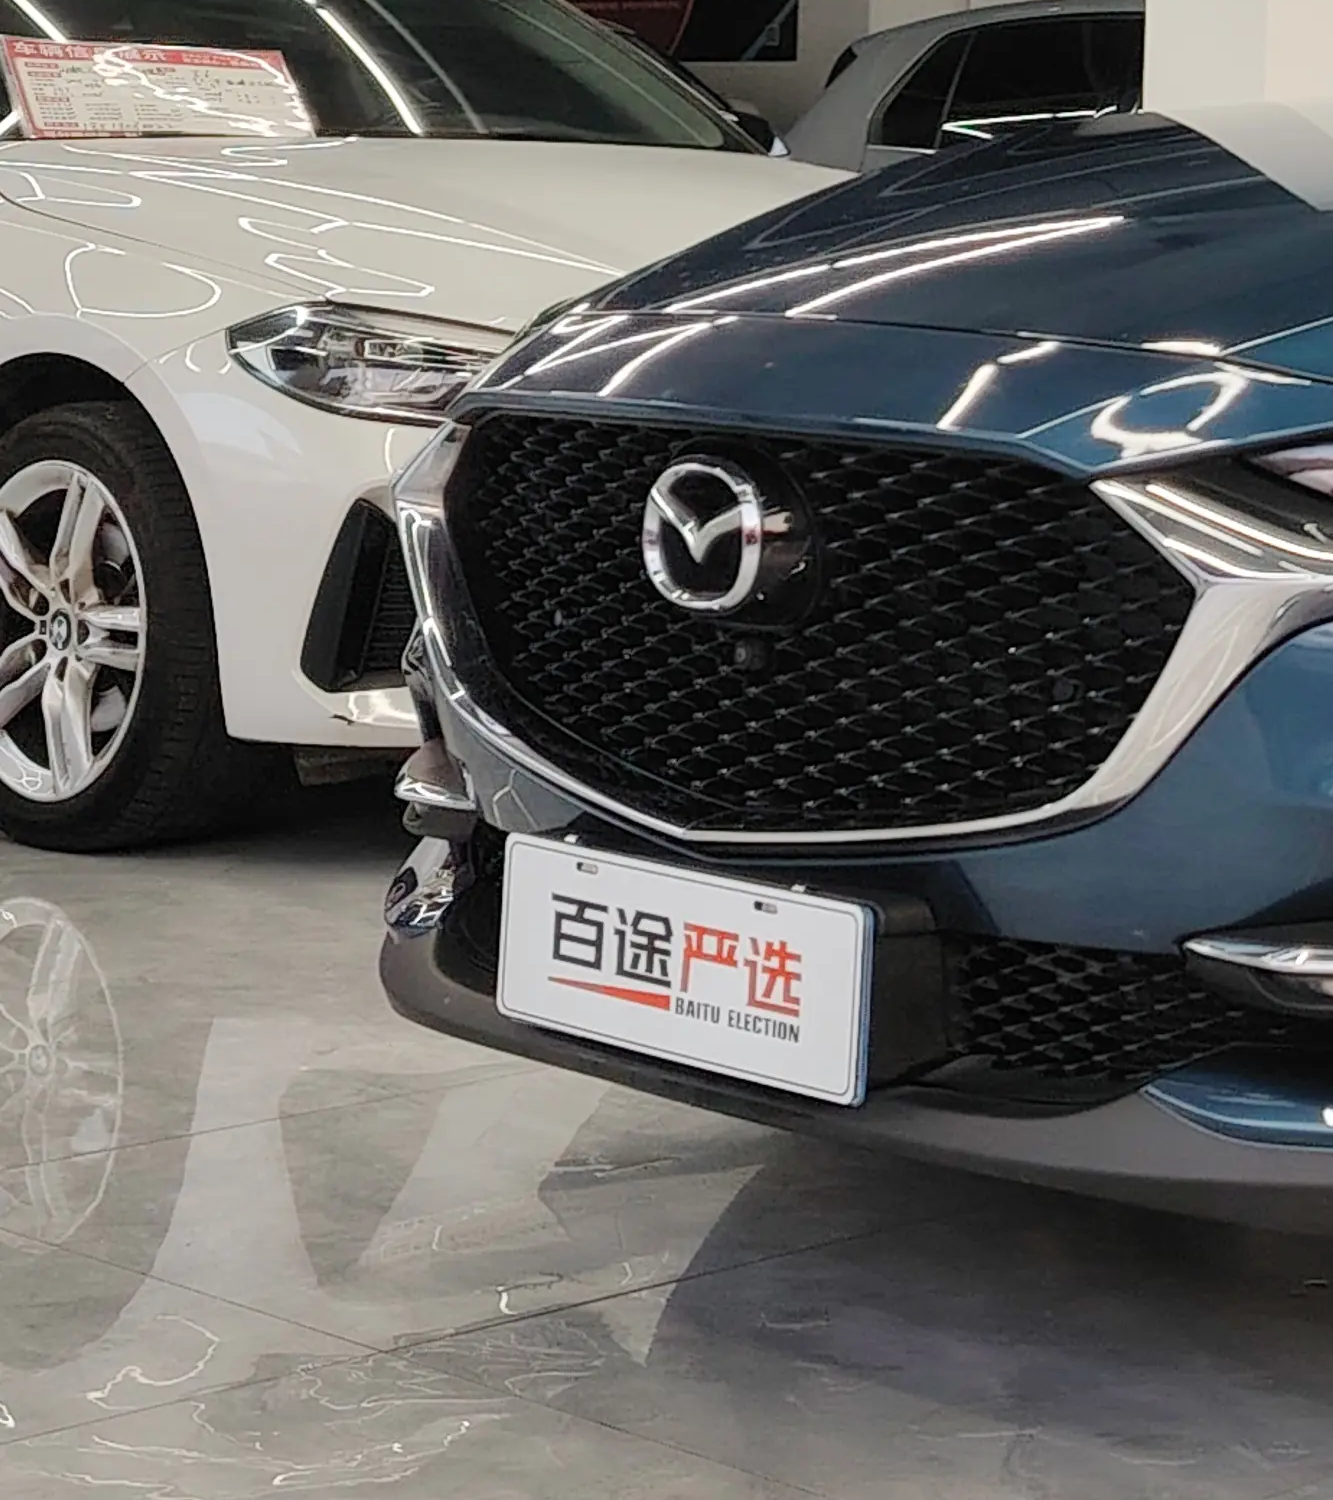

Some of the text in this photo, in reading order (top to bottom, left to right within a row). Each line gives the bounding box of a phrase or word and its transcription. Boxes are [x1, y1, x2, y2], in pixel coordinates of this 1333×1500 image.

[551, 892, 802, 1018] 百途严选
[675, 996, 801, 1044] BAITU ELECTION
